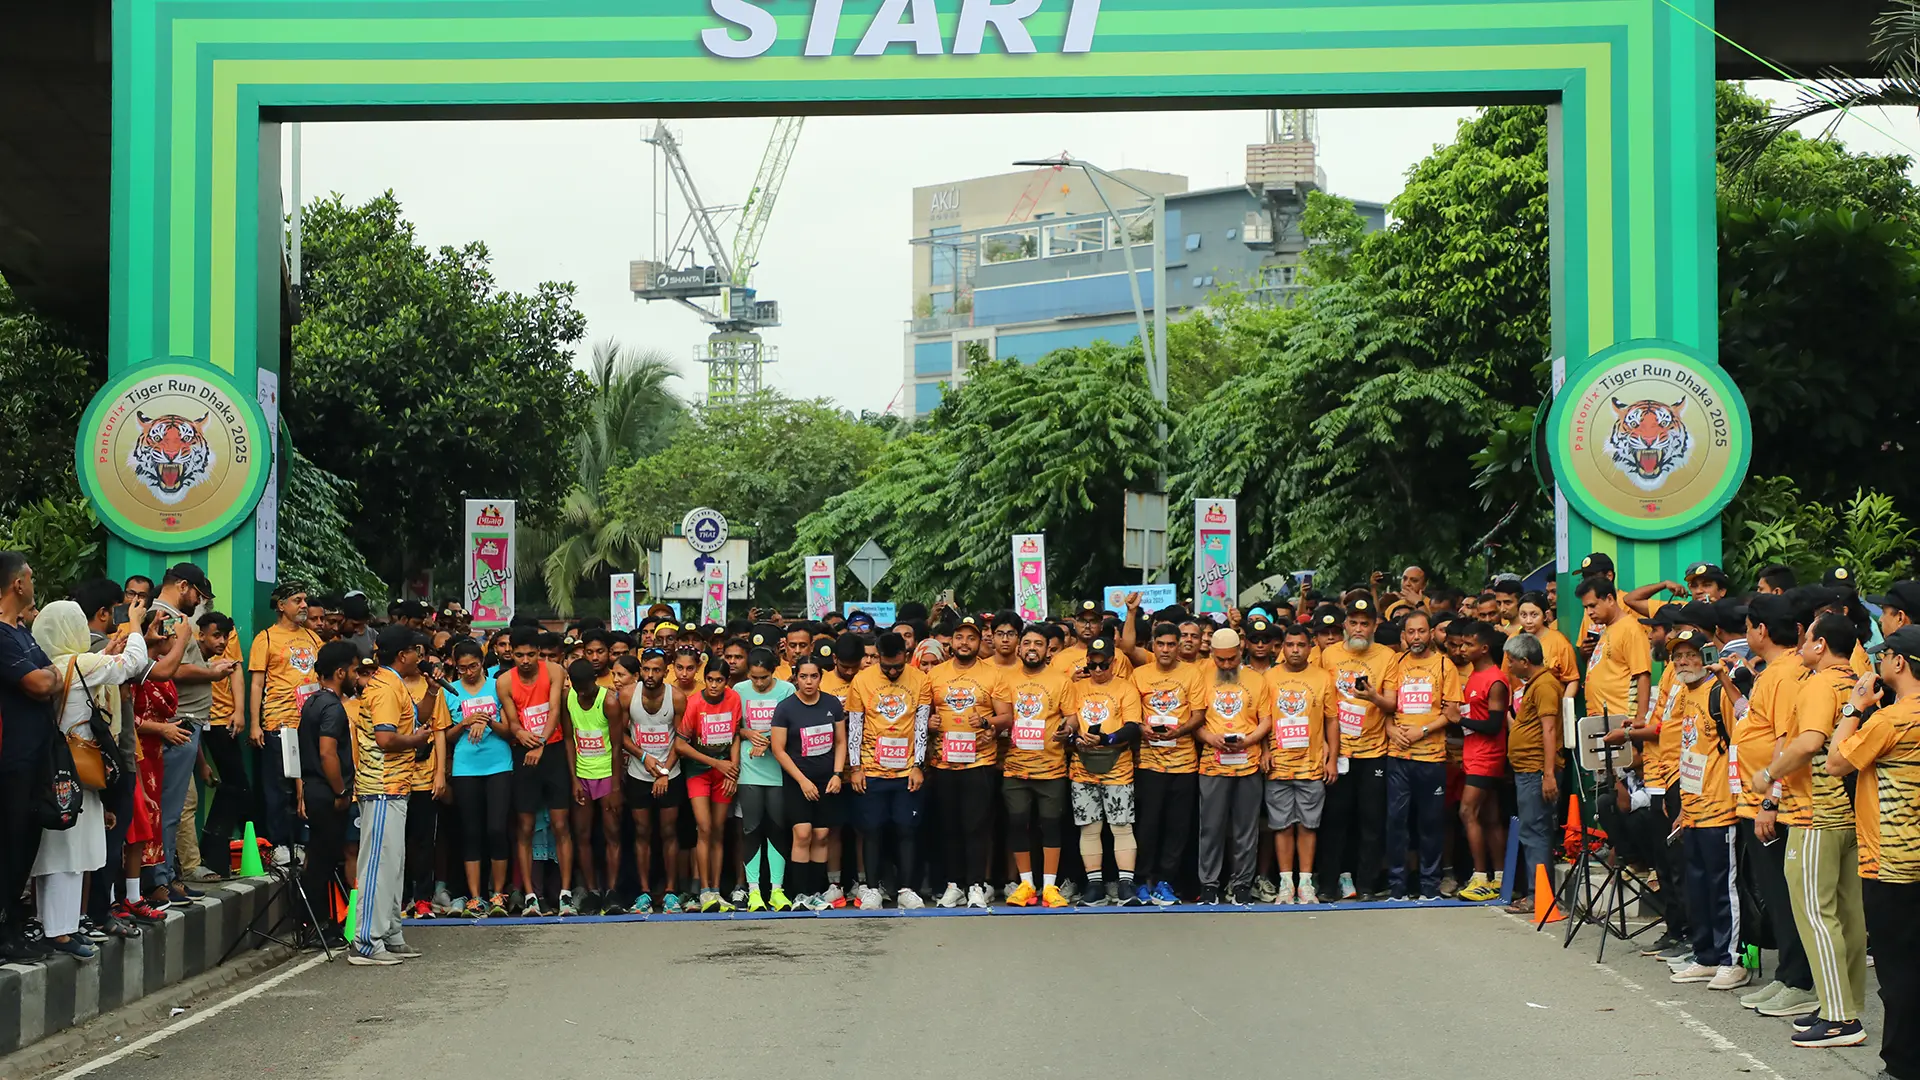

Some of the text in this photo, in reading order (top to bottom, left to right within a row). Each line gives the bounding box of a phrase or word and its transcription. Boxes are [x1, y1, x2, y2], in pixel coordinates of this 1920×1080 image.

[669, 274, 701, 285] SHANTA
[1575, 364, 1728, 451] Pantonix Tiger Run Dhaka 2025
[100, 379, 248, 464] Pantonix Tiger Run Dhaka 2025
[699, 531, 717, 539] THAI
[1405, 693, 1430, 702] 1210
[531, 713, 548, 726] 167
[1339, 711, 1361, 725] 1403
[708, 722, 731, 734] 1023
[1282, 726, 1307, 737] 1315
[641, 734, 666, 743] 1095
[1018, 730, 1042, 738] 1070
[580, 739, 602, 748] 1223
[808, 734, 831, 746] 1696
[882, 747, 906, 757] 1248
[949, 742, 974, 751] 1174
